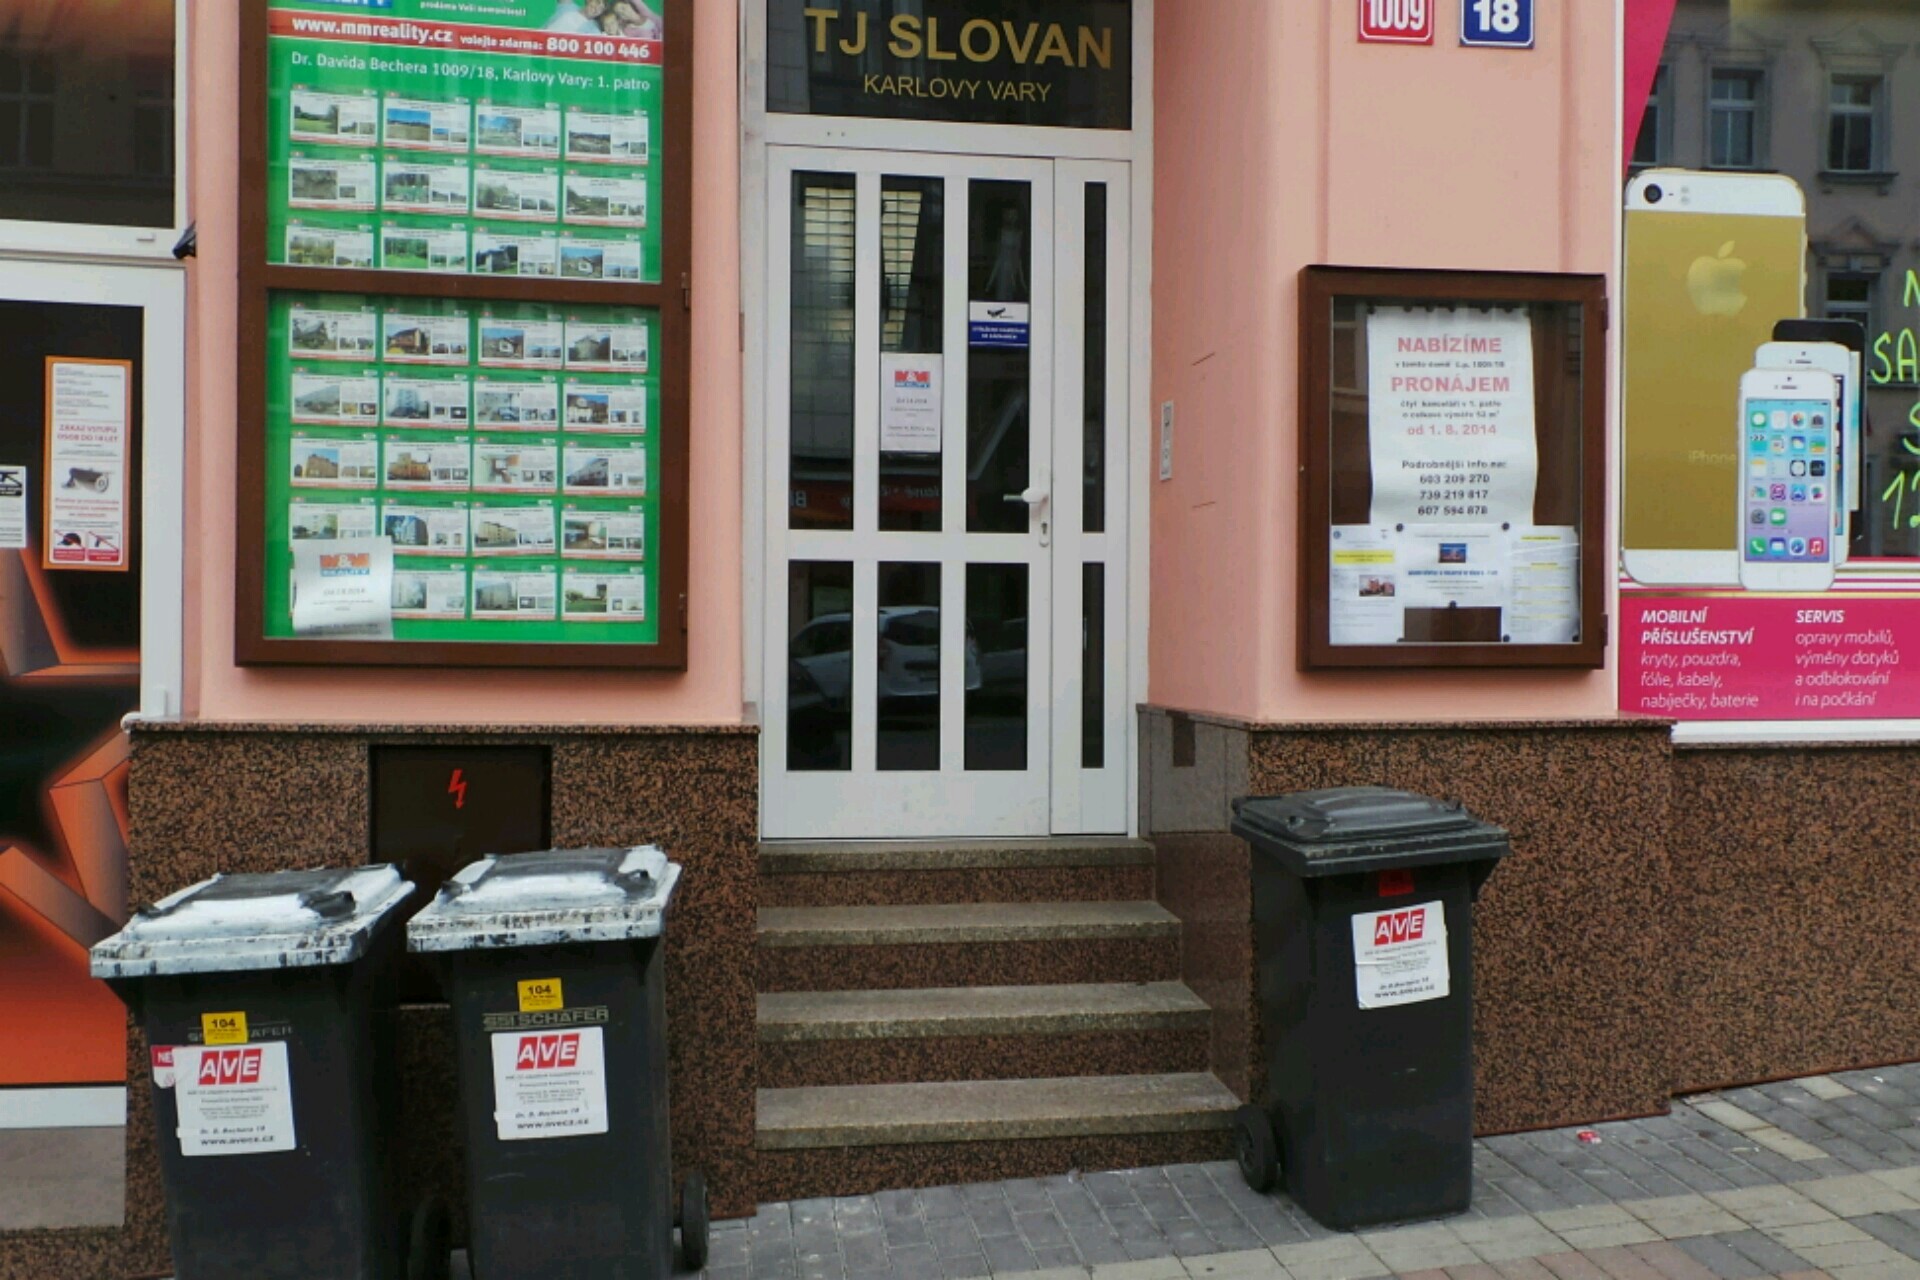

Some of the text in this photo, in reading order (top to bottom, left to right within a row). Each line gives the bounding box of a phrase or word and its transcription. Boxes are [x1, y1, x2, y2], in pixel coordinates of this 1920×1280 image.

[1365, 0, 1425, 30] 1009
[1473, 0, 1520, 33] 18
[291, 18, 650, 58] www.mmreality.cz volejte zdarma: 800 100 446
[804, 8, 1112, 69] TJ SLOVAN
[291, 51, 650, 91] Dr. Davida Bechera 1009/18, Karlovy Vary: 1. patro
[864, 74, 1051, 102] KARLOVY VARY
[1397, 333, 1502, 353] NABÍZÍME
[1391, 373, 1510, 392] PRONÁJEM
[1407, 424, 1424, 436] od
[1429, 424, 1441, 436] 1.
[1462, 424, 1497, 435] 2014
[1402, 460, 1464, 470] Podrobnější
[1467, 460, 1488, 468] info
[1641, 606, 1708, 623] MOBILNÍ
[1796, 610, 1845, 624] SERVIS
[1641, 627, 1755, 645] PŘÍSLUŠENSTVÍ
[1796, 629, 1895, 647] opravy mobilů,
[1641, 652, 1741, 668] kryty, pouzdra,
[1796, 649, 1900, 667] výměny dotyků
[1641, 672, 1724, 689] fólie, kabely,
[1796, 670, 1891, 686] a odblokování
[1641, 693, 1759, 710] nabíječky, baterie
[1803, 695, 1819, 706] na
[1821, 691, 1877, 708] počkání
[1375, 911, 1424, 942] AVE
[528, 985, 552, 995] 104
[211, 1018, 236, 1028] 104
[517, 1037, 579, 1066] AVE
[199, 1051, 262, 1080] AVE
